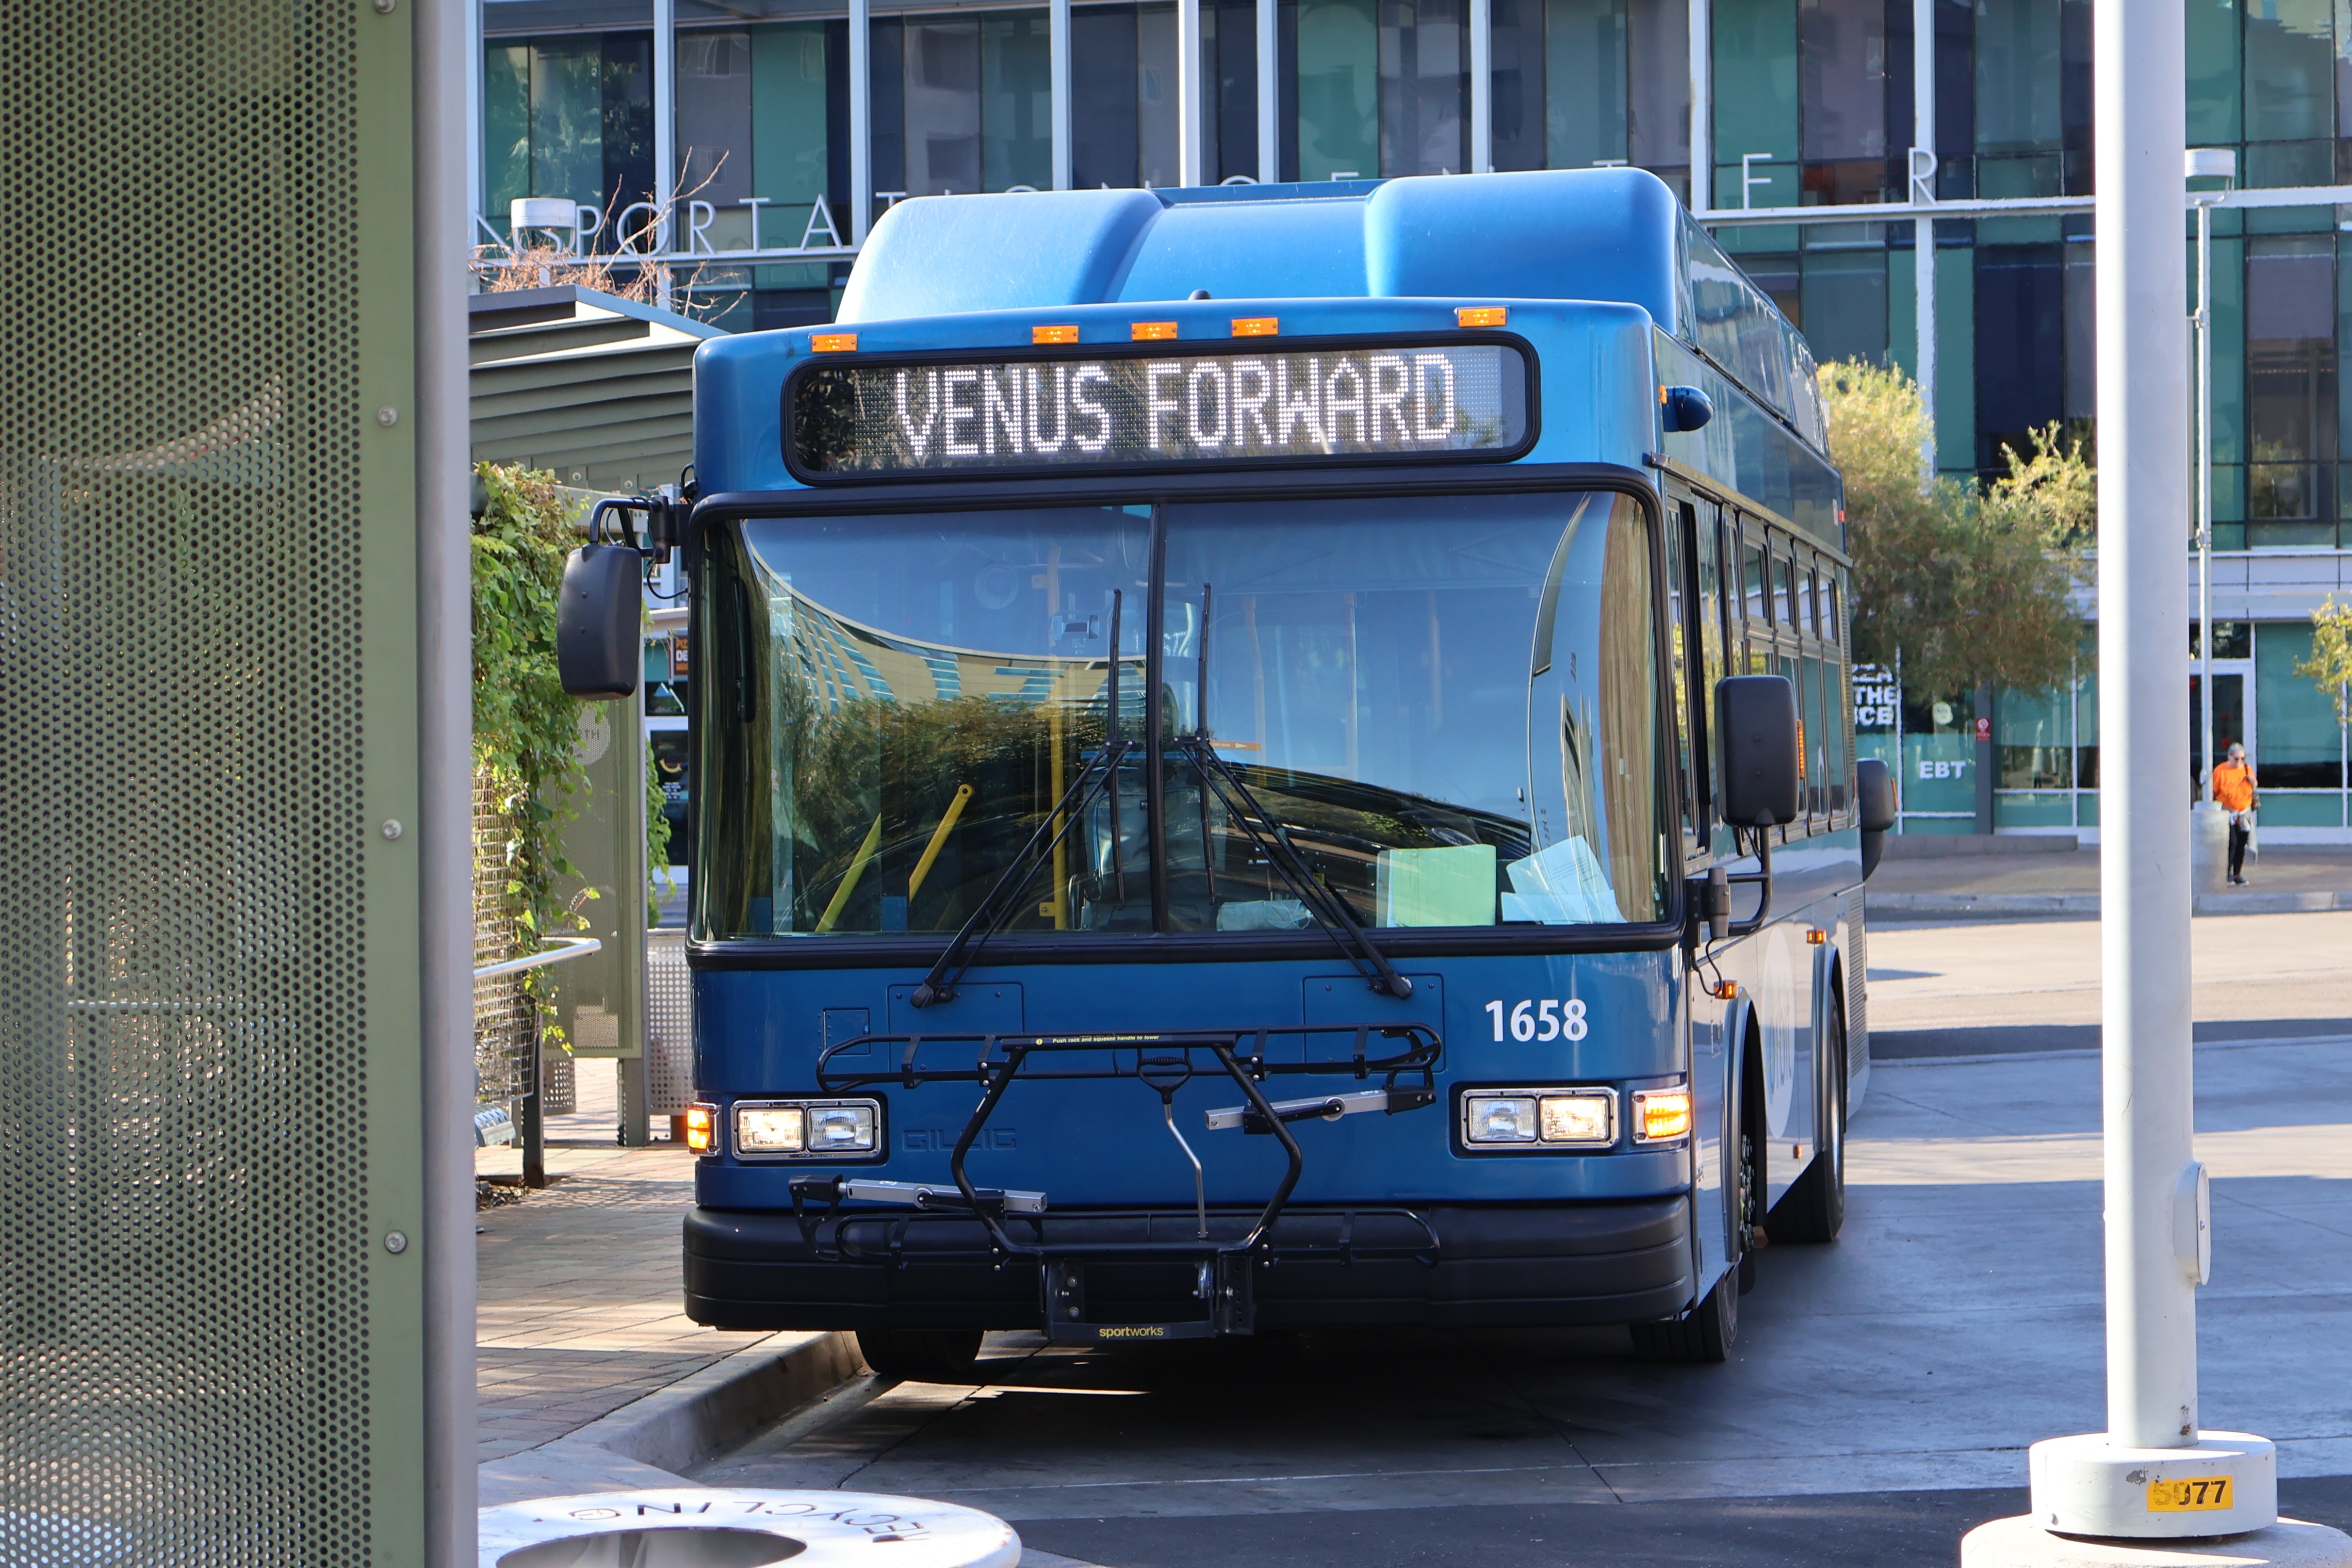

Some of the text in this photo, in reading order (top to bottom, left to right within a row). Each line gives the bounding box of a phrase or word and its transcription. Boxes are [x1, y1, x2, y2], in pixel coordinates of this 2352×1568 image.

[894, 353, 1456, 457] VENUS FORWARD
[1854, 685, 1897, 705] THE
[1920, 760, 1966, 779] EBT
[1485, 998, 1588, 1042] 1658
[1099, 1326, 1164, 1339] sportworks
[2153, 1480, 2226, 1505] 5077
[568, 1501, 931, 1542] RECYCLING
